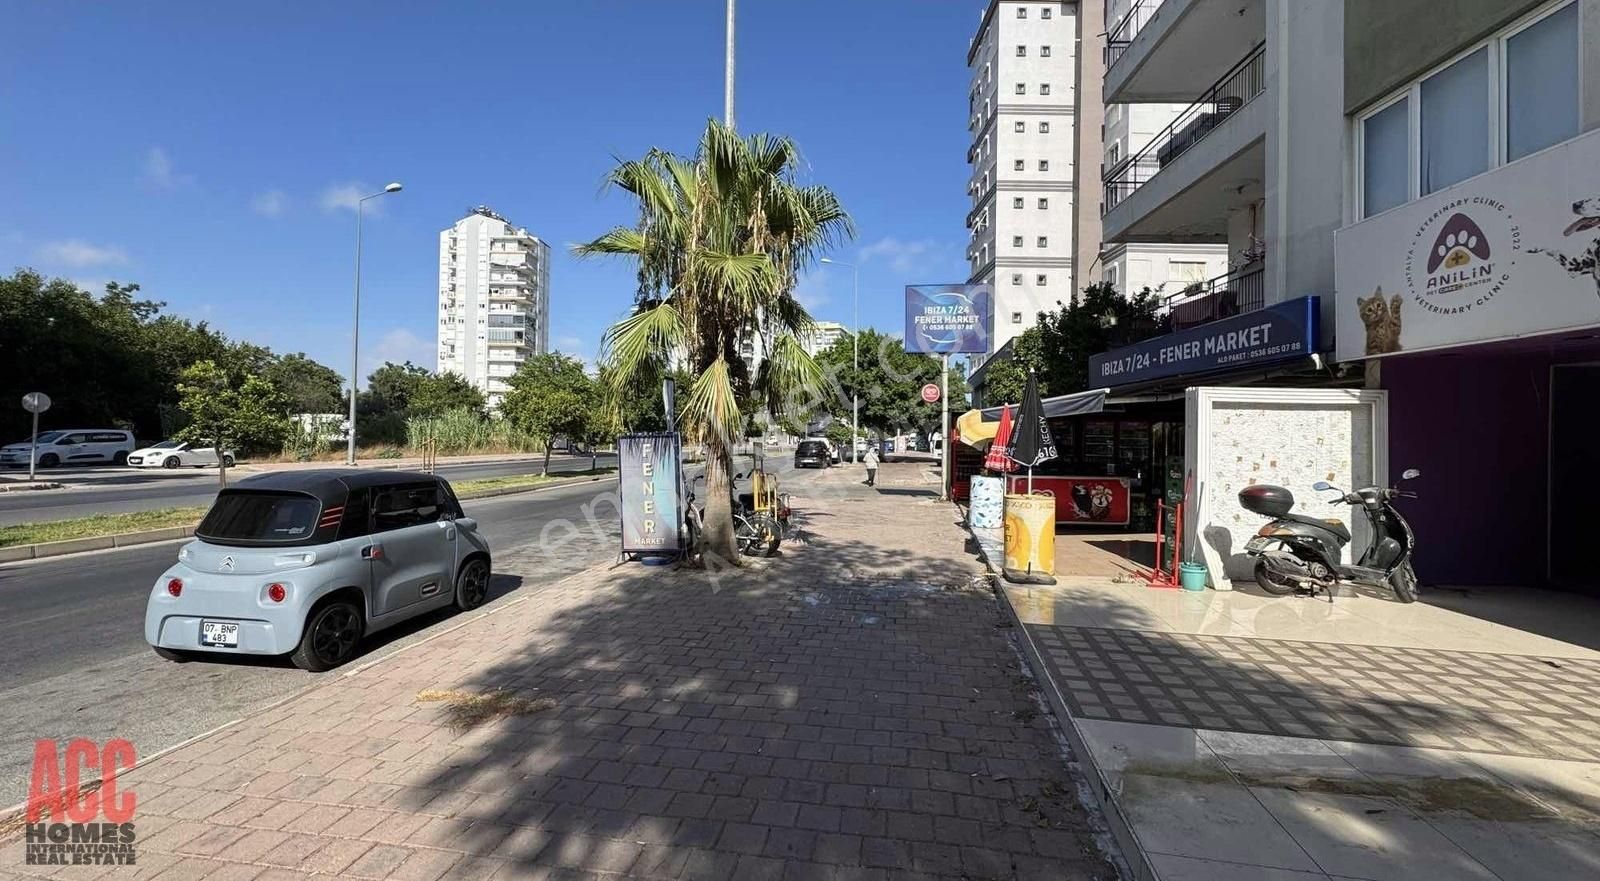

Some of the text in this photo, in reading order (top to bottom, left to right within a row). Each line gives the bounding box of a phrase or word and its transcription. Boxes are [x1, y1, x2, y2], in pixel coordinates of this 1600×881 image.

[1415, 197, 1505, 237] VETERINARY CLINIC
[1510, 225, 1521, 250] 2022
[1414, 273, 1510, 315] VETERINARY CLINIC
[914, 315, 980, 324] FENER MARKET
[924, 305, 970, 315] IBIZA 7/24
[1101, 358, 1124, 377] IBIZA
[1125, 352, 1150, 374] 7/24
[1159, 341, 1201, 365] FENER
[1204, 323, 1272, 356] MARKET
[1217, 356, 1228, 364] ALO
[1228, 352, 1246, 362] PAKET
[1250, 348, 1266, 358] 0536
[1267, 345, 1280, 355] 605
[1281, 343, 1290, 353] 07
[1290, 342, 1301, 351] 88
[642, 443, 656, 534] FENER
[634, 537, 665, 546] MARKET
[204, 623, 238, 634] 07 BNP
[212, 633, 227, 643] 483
